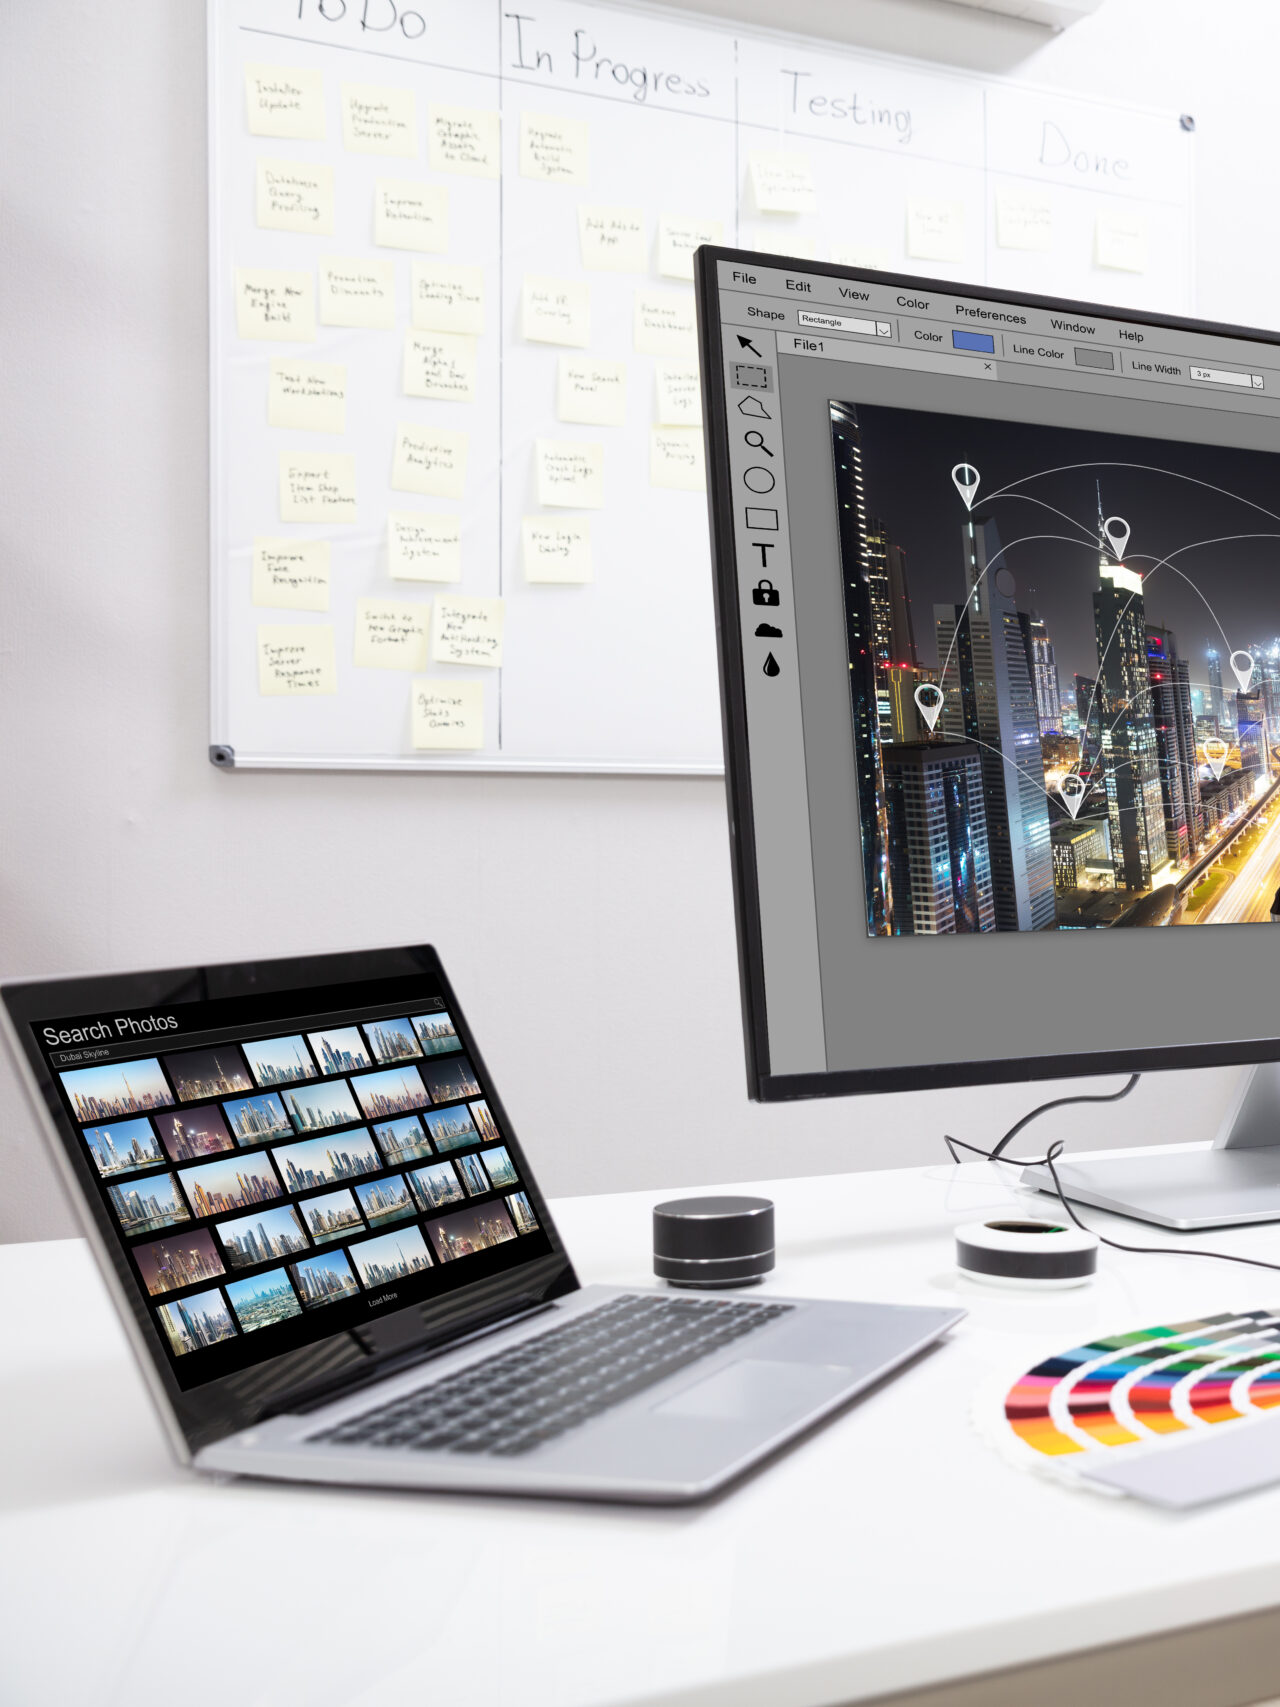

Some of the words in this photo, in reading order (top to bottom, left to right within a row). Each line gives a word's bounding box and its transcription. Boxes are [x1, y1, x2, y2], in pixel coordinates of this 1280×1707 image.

[361, 0, 426, 39] Do
[503, 13, 553, 73] In
[571, 29, 711, 104] Progress
[258, 97, 301, 112] Update
[780, 69, 913, 143] Testing
[1038, 120, 1132, 180] Done
[269, 186, 304, 204] Query
[244, 283, 276, 300] Merge
[732, 271, 757, 285] File
[785, 279, 812, 294] Edit
[838, 287, 870, 302] View
[896, 295, 930, 311] Color
[955, 303, 1027, 326] Preferences
[1050, 318, 1096, 336] Window
[1119, 328, 1145, 344] Help
[747, 306, 786, 322] Shape
[802, 315, 843, 328] Rectangle
[914, 330, 944, 343] Color
[1013, 344, 1035, 357] Line
[1037, 347, 1065, 361] Color
[1132, 361, 1153, 373] Line
[1155, 363, 1182, 377] Width
[1203, 371, 1211, 379] px
[793, 338, 825, 353] File1
[261, 549, 305, 564] Improve
[449, 643, 493, 658] System
[42, 1021, 113, 1046] Search
[114, 1015, 179, 1036] Photos
[60, 1052, 83, 1063] Dubai
[84, 1047, 111, 1060] Skyline
[367, 1296, 384, 1308] Load
[382, 1292, 399, 1303] More
